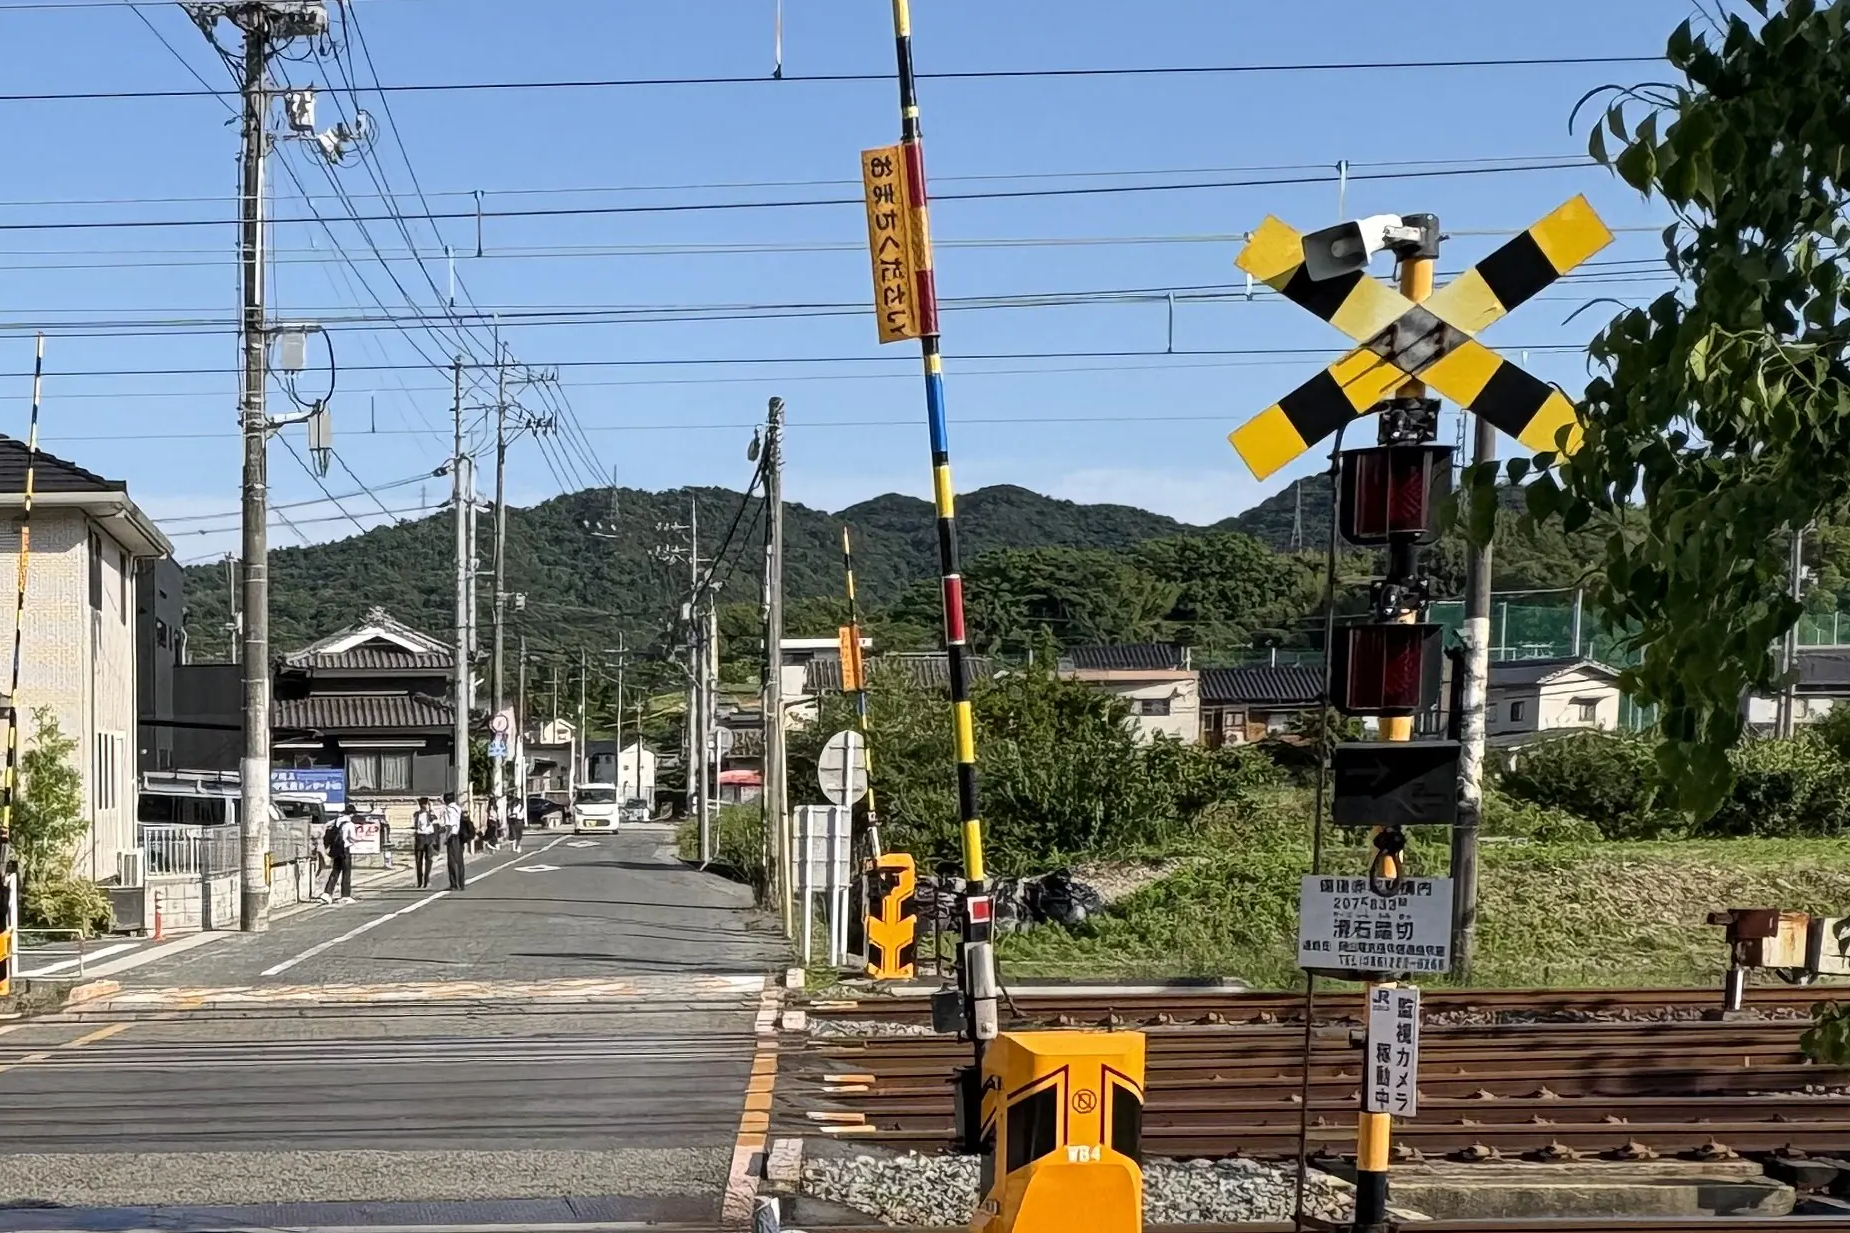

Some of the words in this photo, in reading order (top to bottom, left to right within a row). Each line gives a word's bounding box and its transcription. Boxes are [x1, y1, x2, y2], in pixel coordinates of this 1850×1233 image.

[870, 154, 907, 336] おまちください
[1372, 989, 1390, 1004] JR
[1395, 997, 1414, 1111] 監視カメラ
